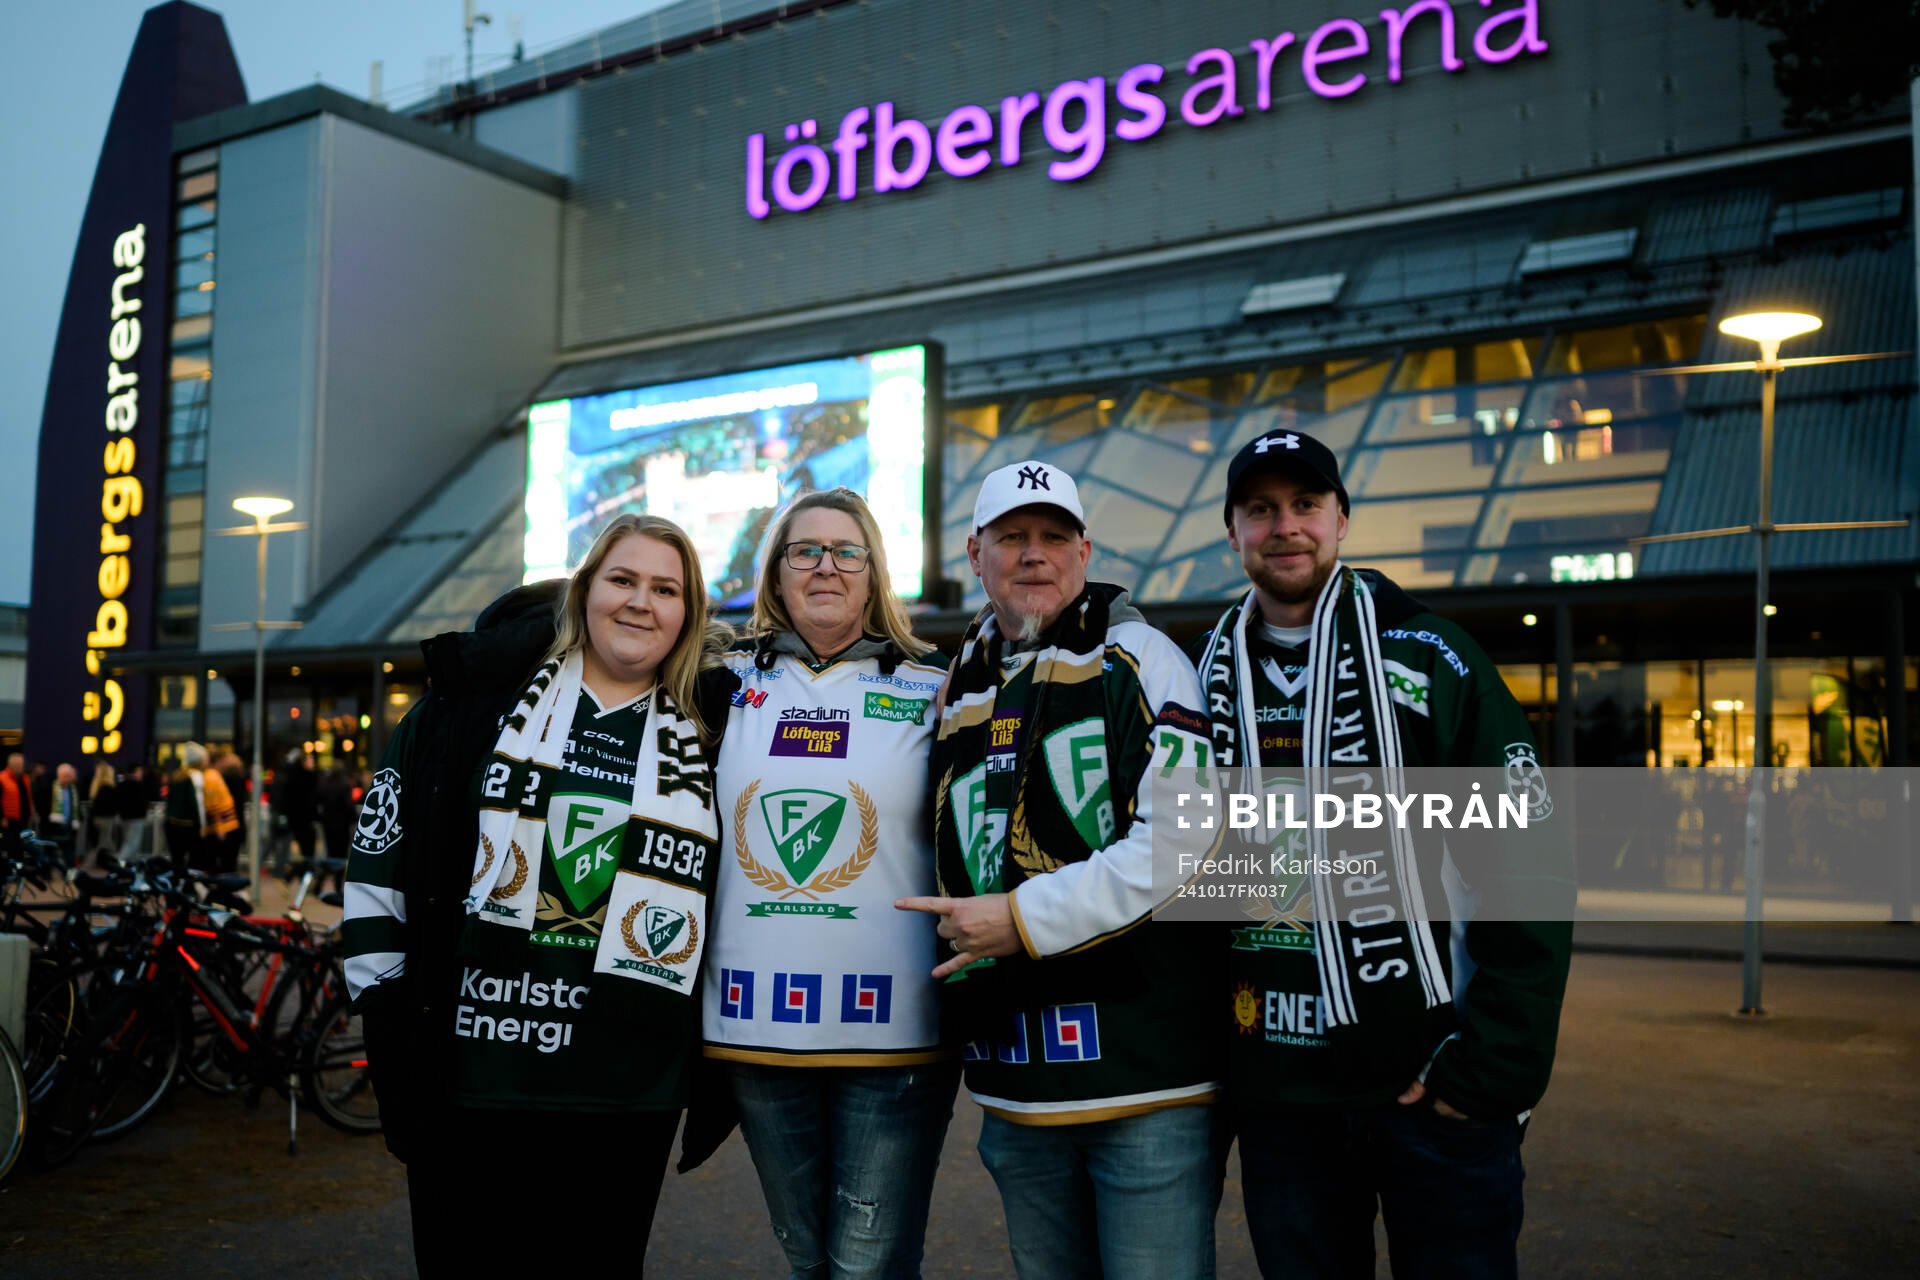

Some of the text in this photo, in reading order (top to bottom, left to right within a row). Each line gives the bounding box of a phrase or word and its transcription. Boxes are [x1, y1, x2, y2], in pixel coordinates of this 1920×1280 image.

[1017, 465, 1051, 491] NY
[779, 706, 850, 721] stadium
[1255, 704, 1306, 722] stadiu
[582, 730, 625, 747] CCM
[782, 726, 841, 744] Löfbergs
[807, 740, 833, 753] Lila
[1160, 731, 1210, 789] 71
[562, 803, 605, 852] F
[783, 800, 808, 837] F
[638, 828, 707, 881] 1932
[793, 820, 823, 863] BK
[574, 834, 619, 884] BK
[764, 904, 836, 914] KARLSTAD
